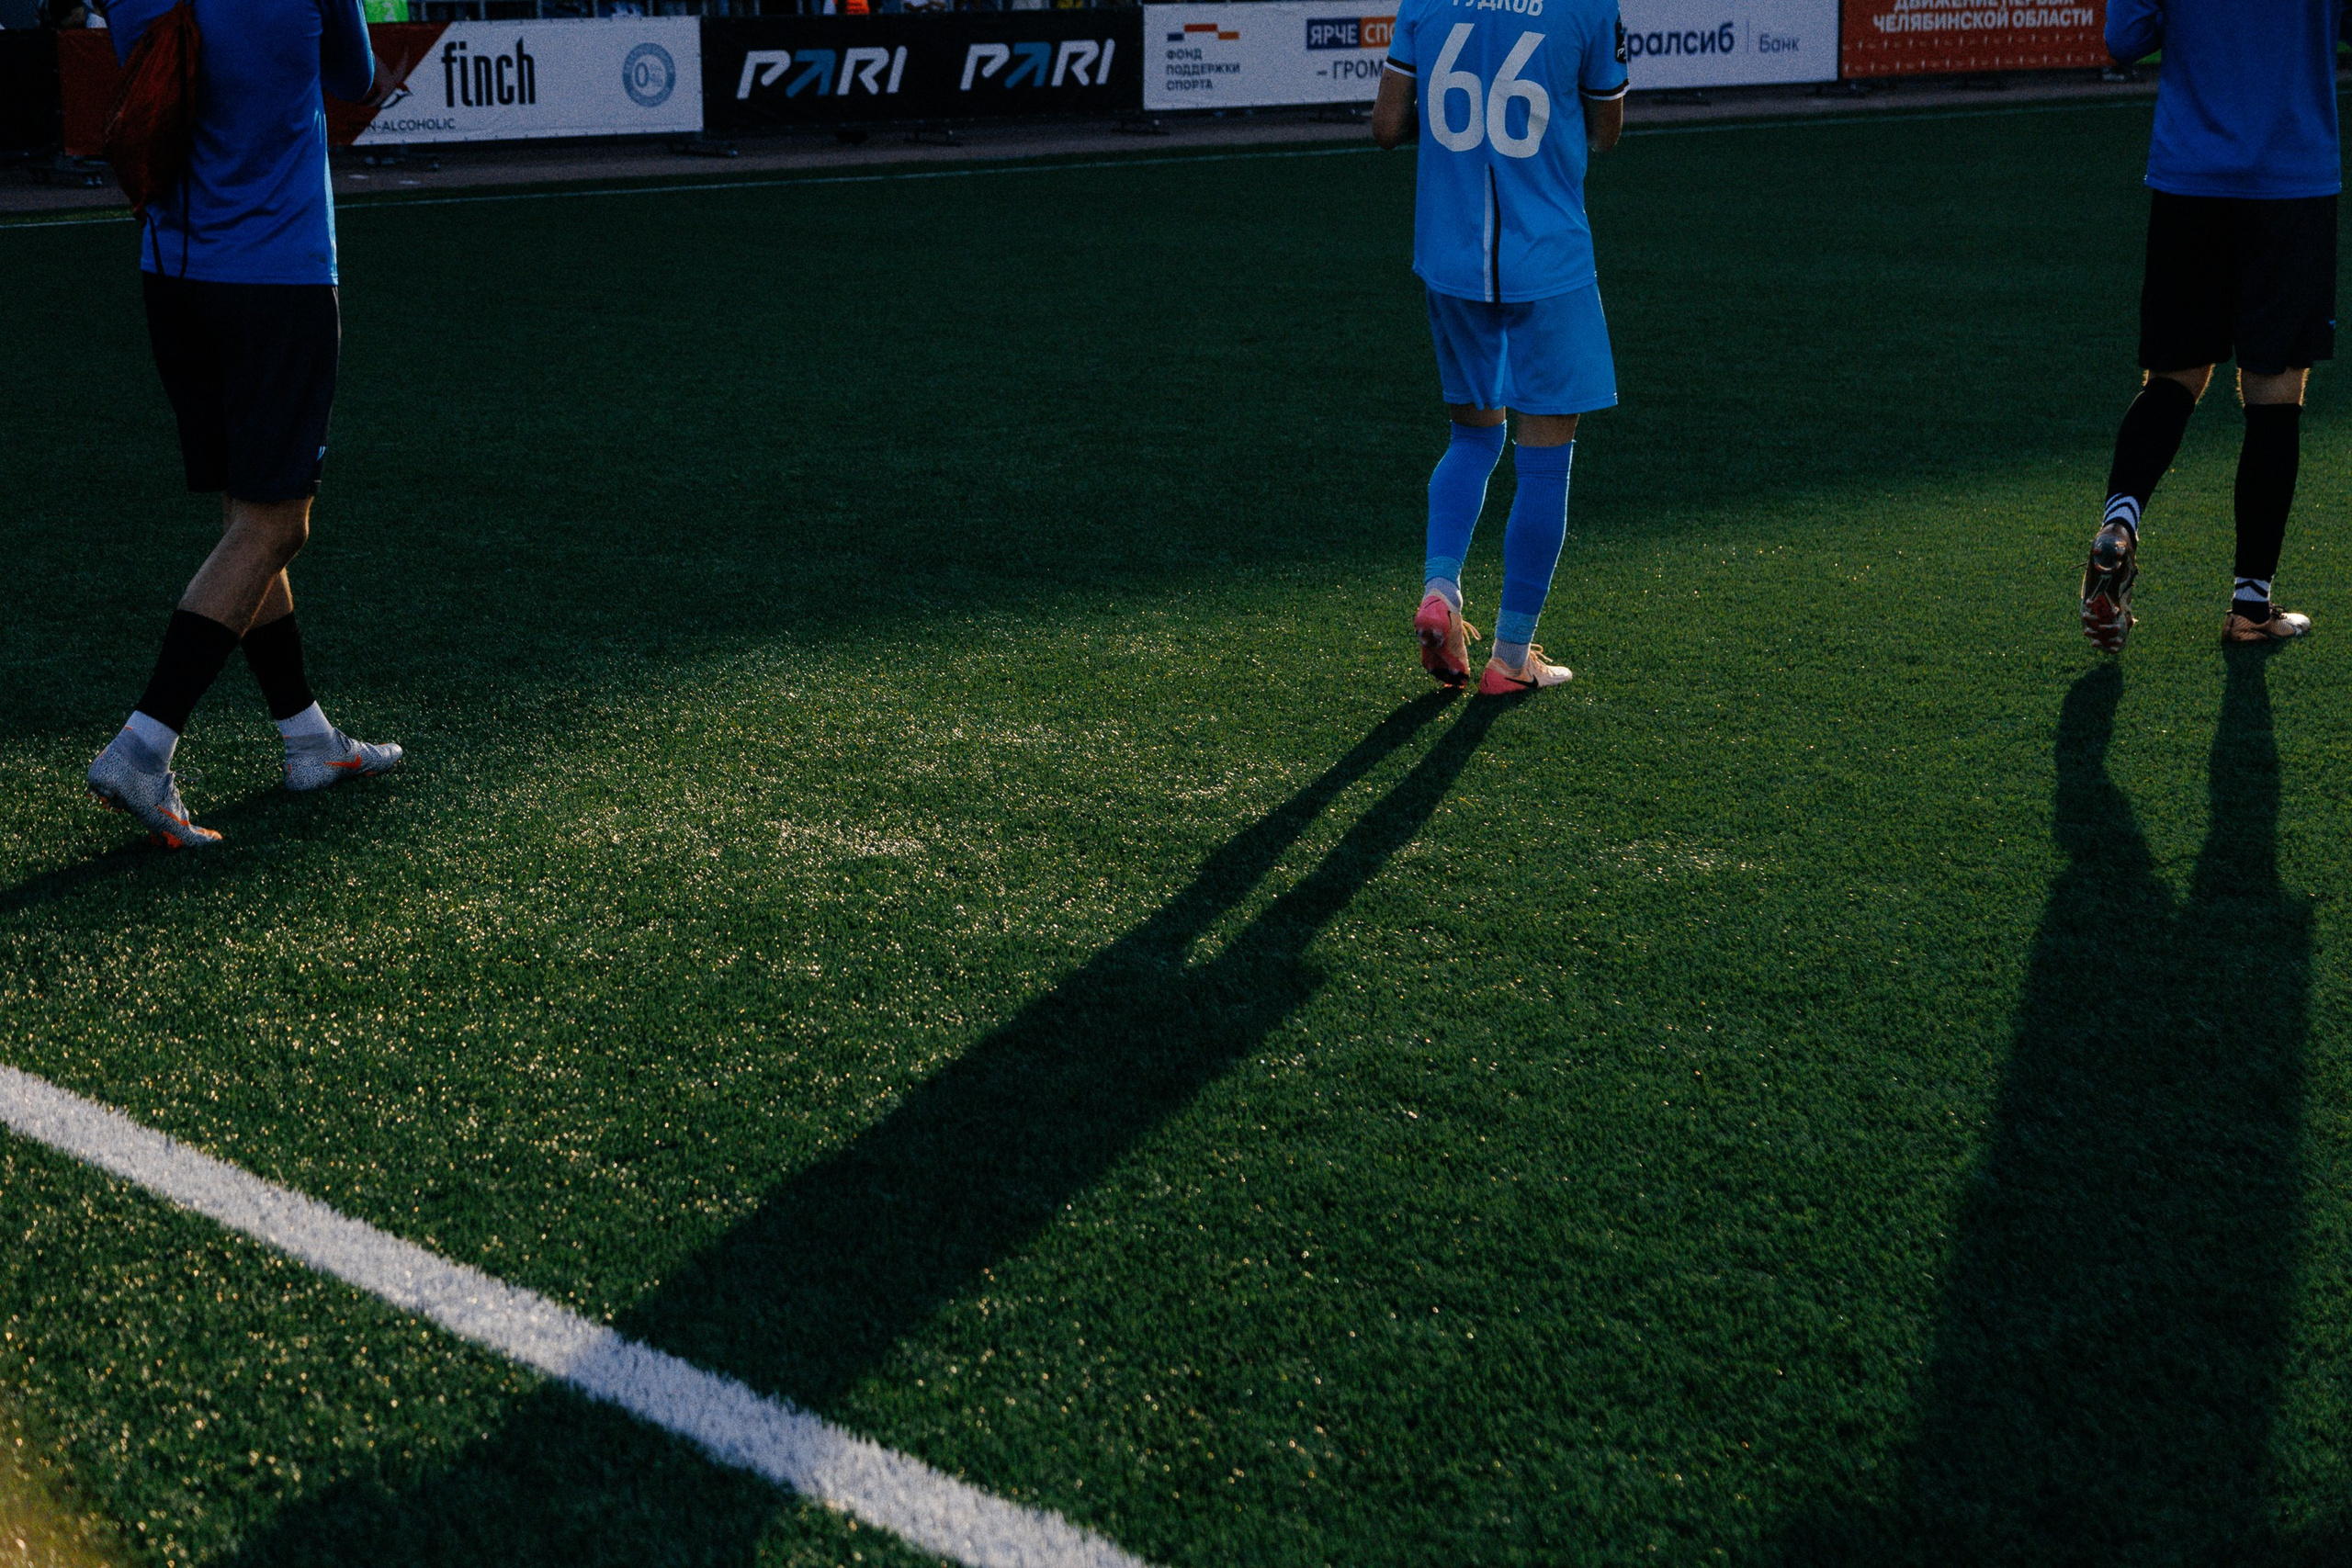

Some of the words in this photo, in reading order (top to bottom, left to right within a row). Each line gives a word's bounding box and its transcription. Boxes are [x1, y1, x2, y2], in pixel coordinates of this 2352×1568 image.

[1873, 8, 2009, 33] ЧЕЛЯБИНСКОЙ
[2012, 7, 2094, 28] ОБЛАСТИ
[1310, 24, 1358, 45] ЯРЧЕ
[1623, 21, 1735, 62] ралсиб
[1758, 33, 1800, 53] Банк
[960, 39, 1115, 91] PARI
[1166, 48, 1203, 61] ФОНД
[441, 36, 536, 107] finch
[737, 46, 908, 99] PARI
[1166, 62, 1240, 76] ПОДДЕРЖКИ
[1166, 79, 1214, 91] СПОРТА
[1428, 23, 1550, 158] 66
